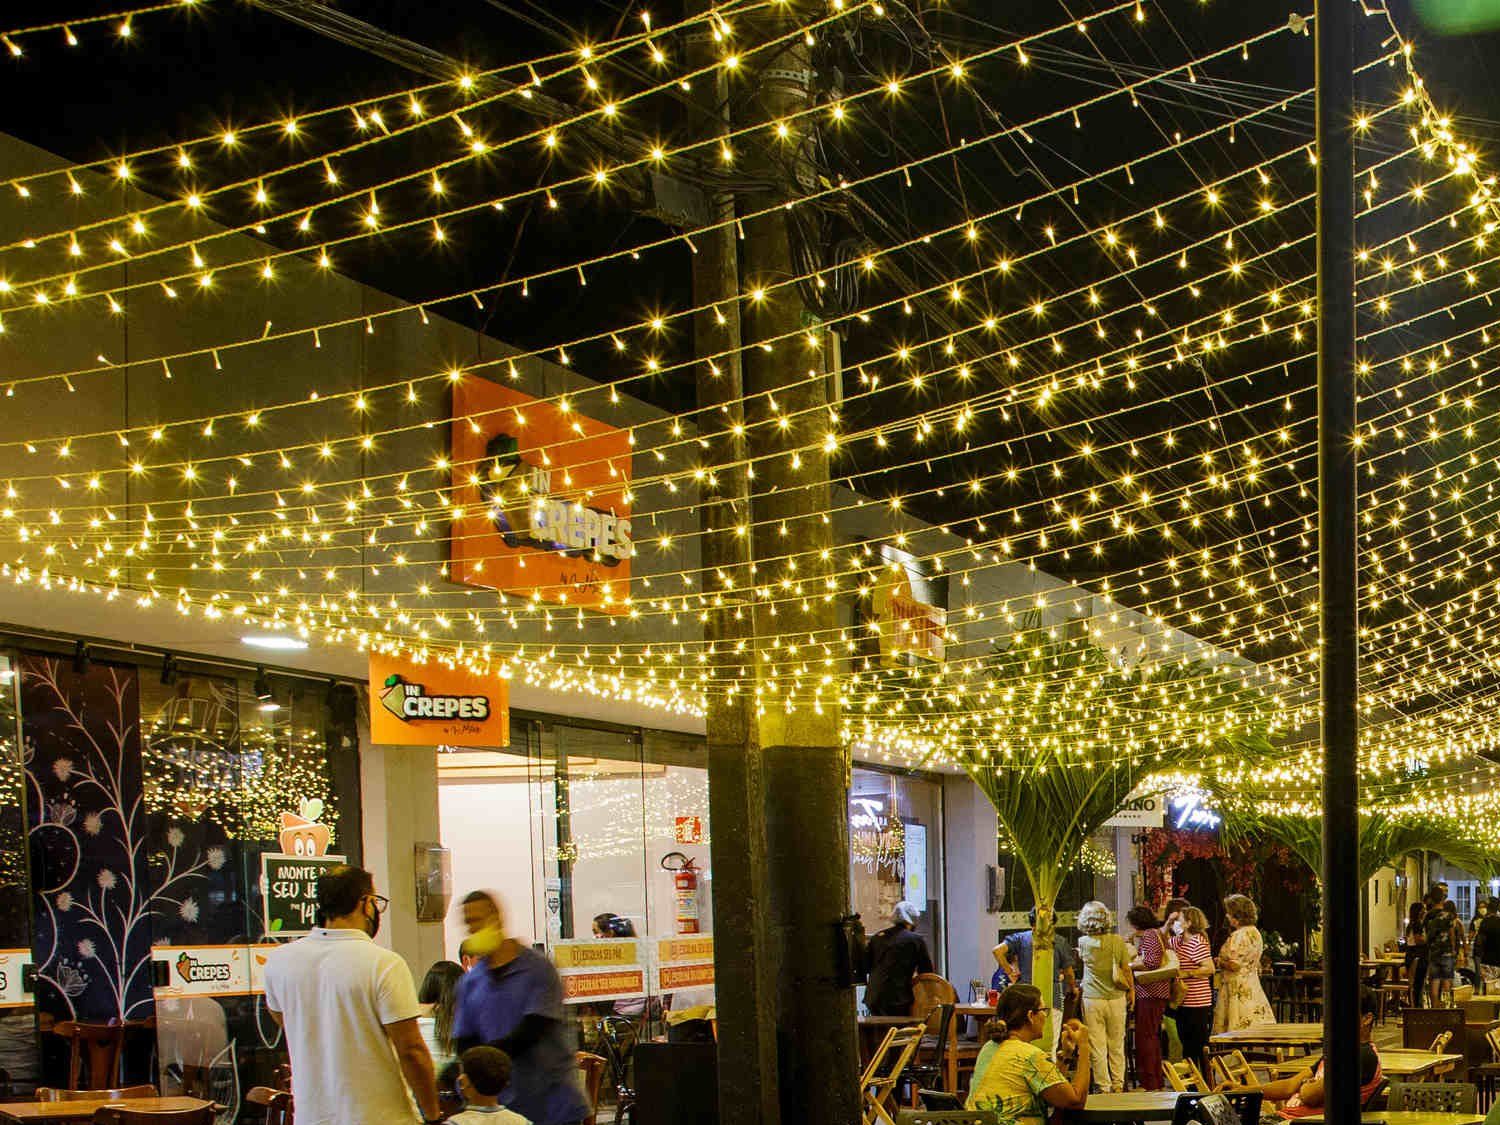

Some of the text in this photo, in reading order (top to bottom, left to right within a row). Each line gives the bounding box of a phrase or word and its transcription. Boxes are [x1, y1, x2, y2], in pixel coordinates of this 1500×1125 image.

[405, 685, 420, 697] IN
[403, 697, 488, 718] CREPES
[278, 866, 317, 880] MONTE
[273, 882, 318, 899] SEU JE
[189, 966, 230, 980] CREPES
